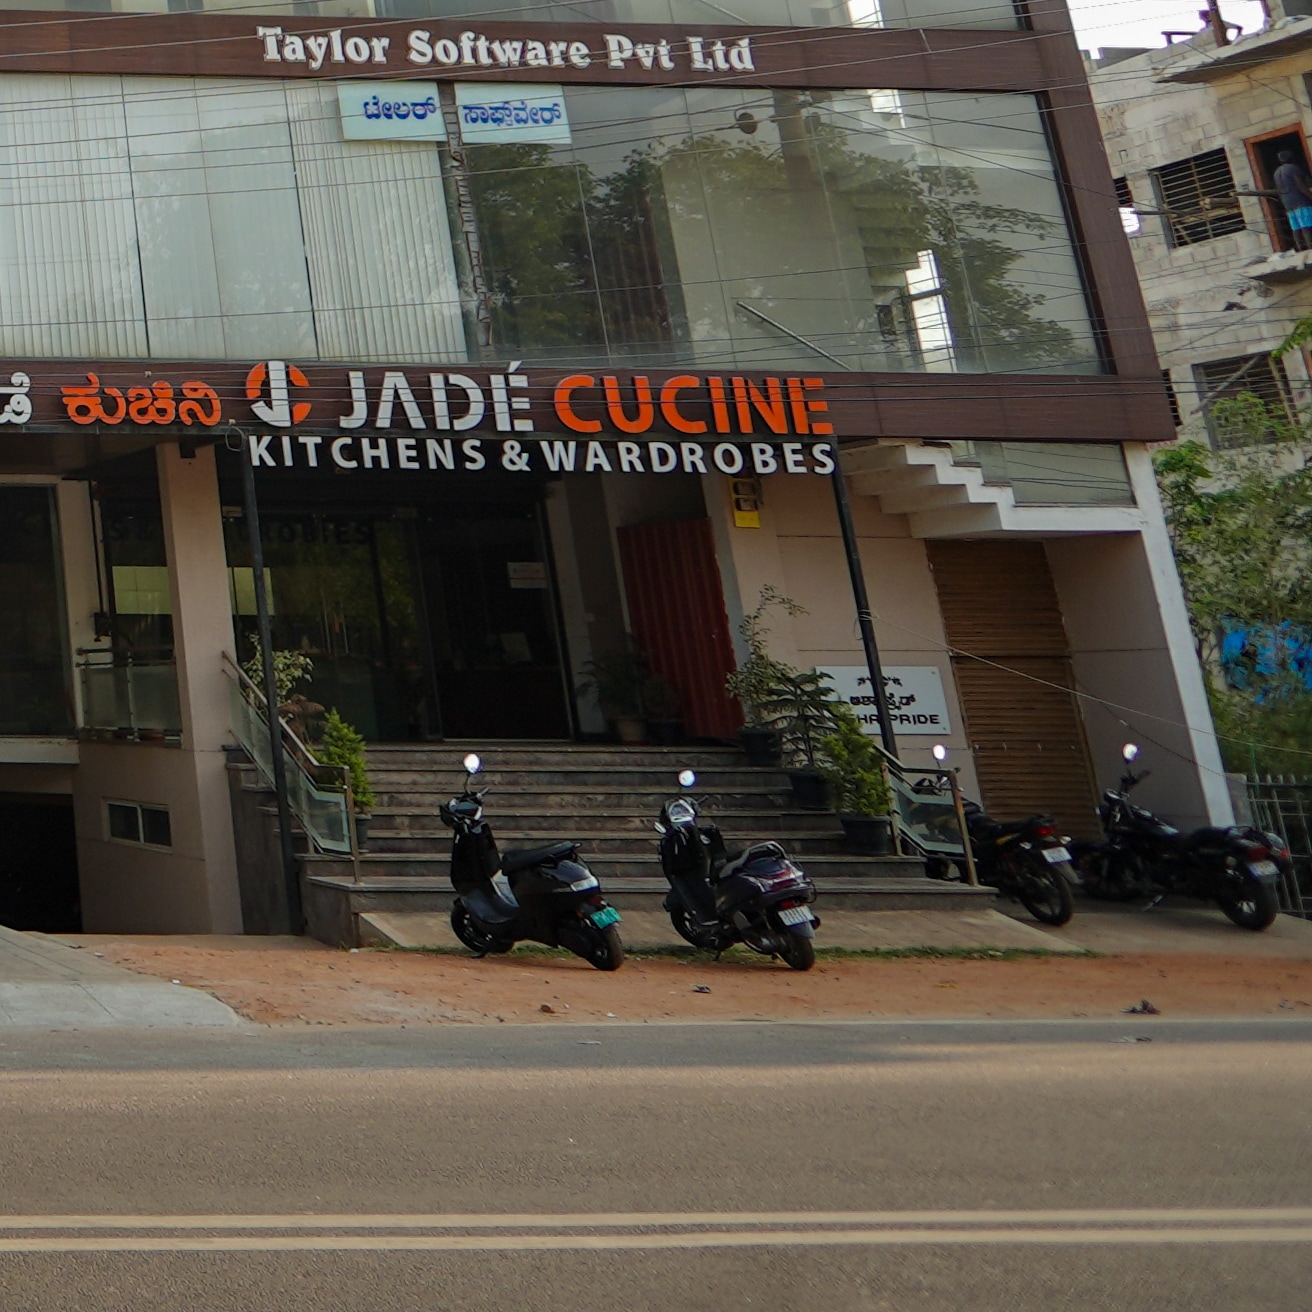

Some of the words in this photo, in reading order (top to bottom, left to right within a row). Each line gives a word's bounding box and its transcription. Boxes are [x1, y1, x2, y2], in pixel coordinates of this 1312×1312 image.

[256, 26, 390, 70] Taylor
[407, 30, 591, 69] Software
[604, 34, 675, 70] Pvt
[685, 37, 756, 73] Ltd
[363, 95, 437, 120] ಟೇಲರ್
[61, 372, 222, 426] ಕುಚಿನಿ
[338, 360, 535, 432] JADÉ
[554, 375, 835, 435] CUCINE
[249, 435, 485, 472] KITCHENS
[502, 440, 531, 473] &
[540, 441, 836, 475] WARDROBES
